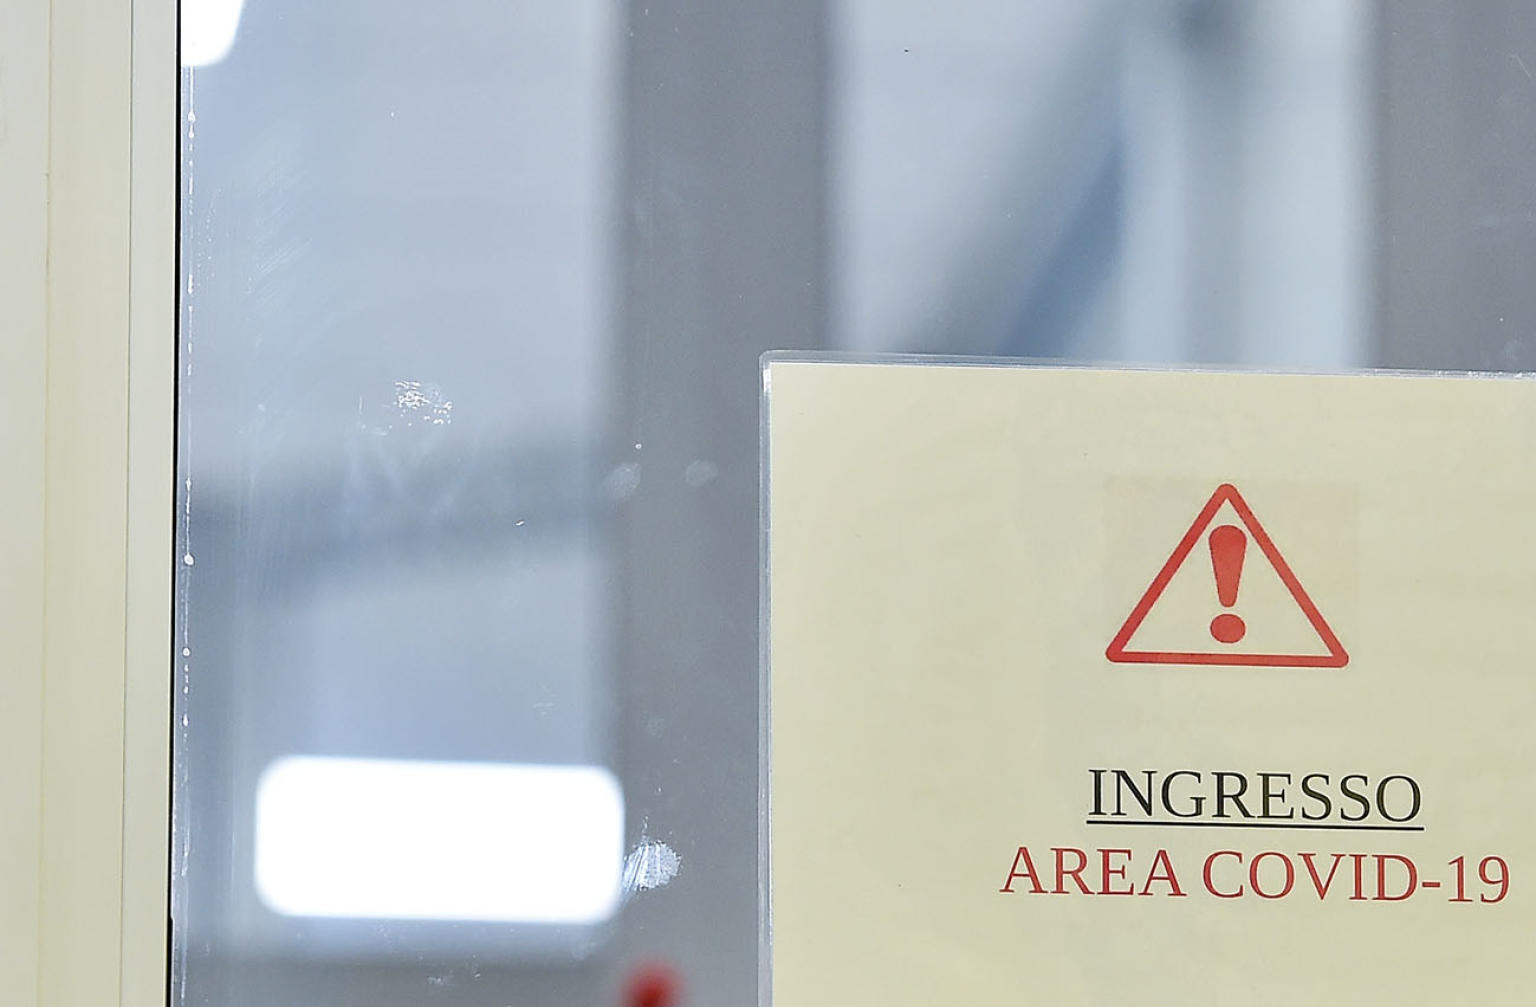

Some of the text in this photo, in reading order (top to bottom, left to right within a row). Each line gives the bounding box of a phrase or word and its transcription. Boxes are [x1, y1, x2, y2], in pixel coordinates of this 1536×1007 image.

[1087, 769, 1421, 823] INGRESSO
[999, 846, 1510, 904] AREA COVID-19
